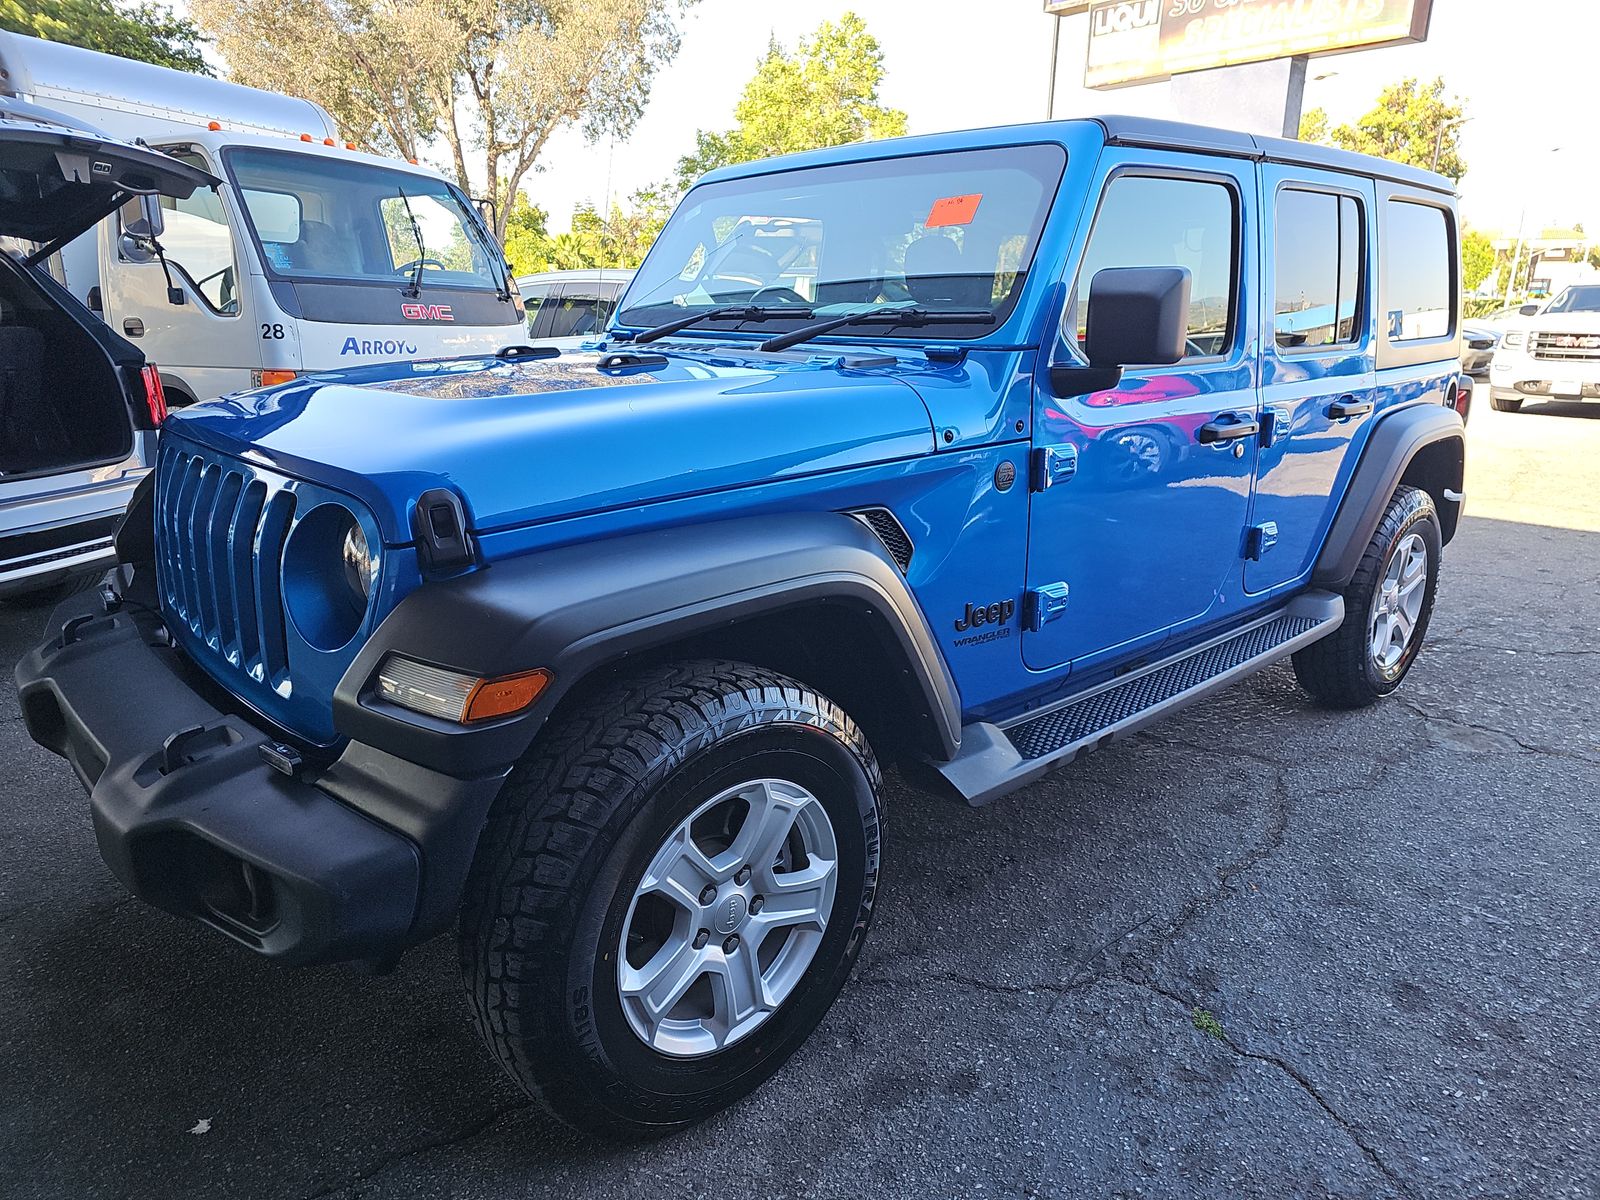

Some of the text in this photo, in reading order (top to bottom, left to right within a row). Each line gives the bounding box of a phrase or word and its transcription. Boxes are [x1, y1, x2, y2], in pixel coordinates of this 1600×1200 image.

[1095, 1, 1158, 36] LIQUI
[402, 303, 454, 320] GMC
[261, 324, 284, 339] 28
[1556, 336, 1600, 347] GMC
[954, 599, 1014, 632] Jeep
[953, 628, 1010, 647] WRANGLER
